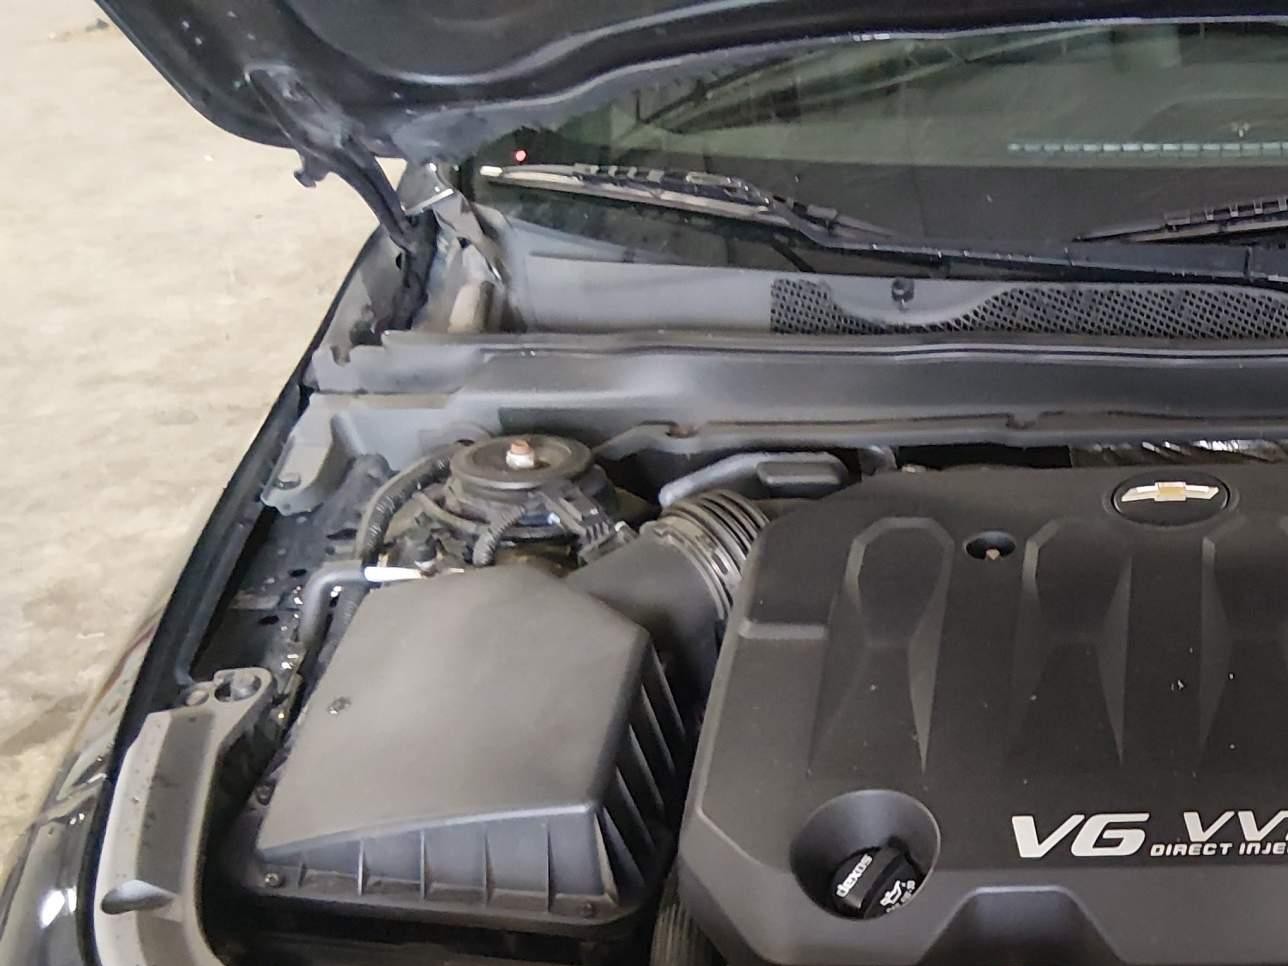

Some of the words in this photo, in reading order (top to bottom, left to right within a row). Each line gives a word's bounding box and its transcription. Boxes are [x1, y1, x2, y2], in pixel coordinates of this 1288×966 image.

[1011, 812, 1150, 858] V6
[1150, 842, 1233, 857] DIRECT
[836, 854, 873, 898] dexos
